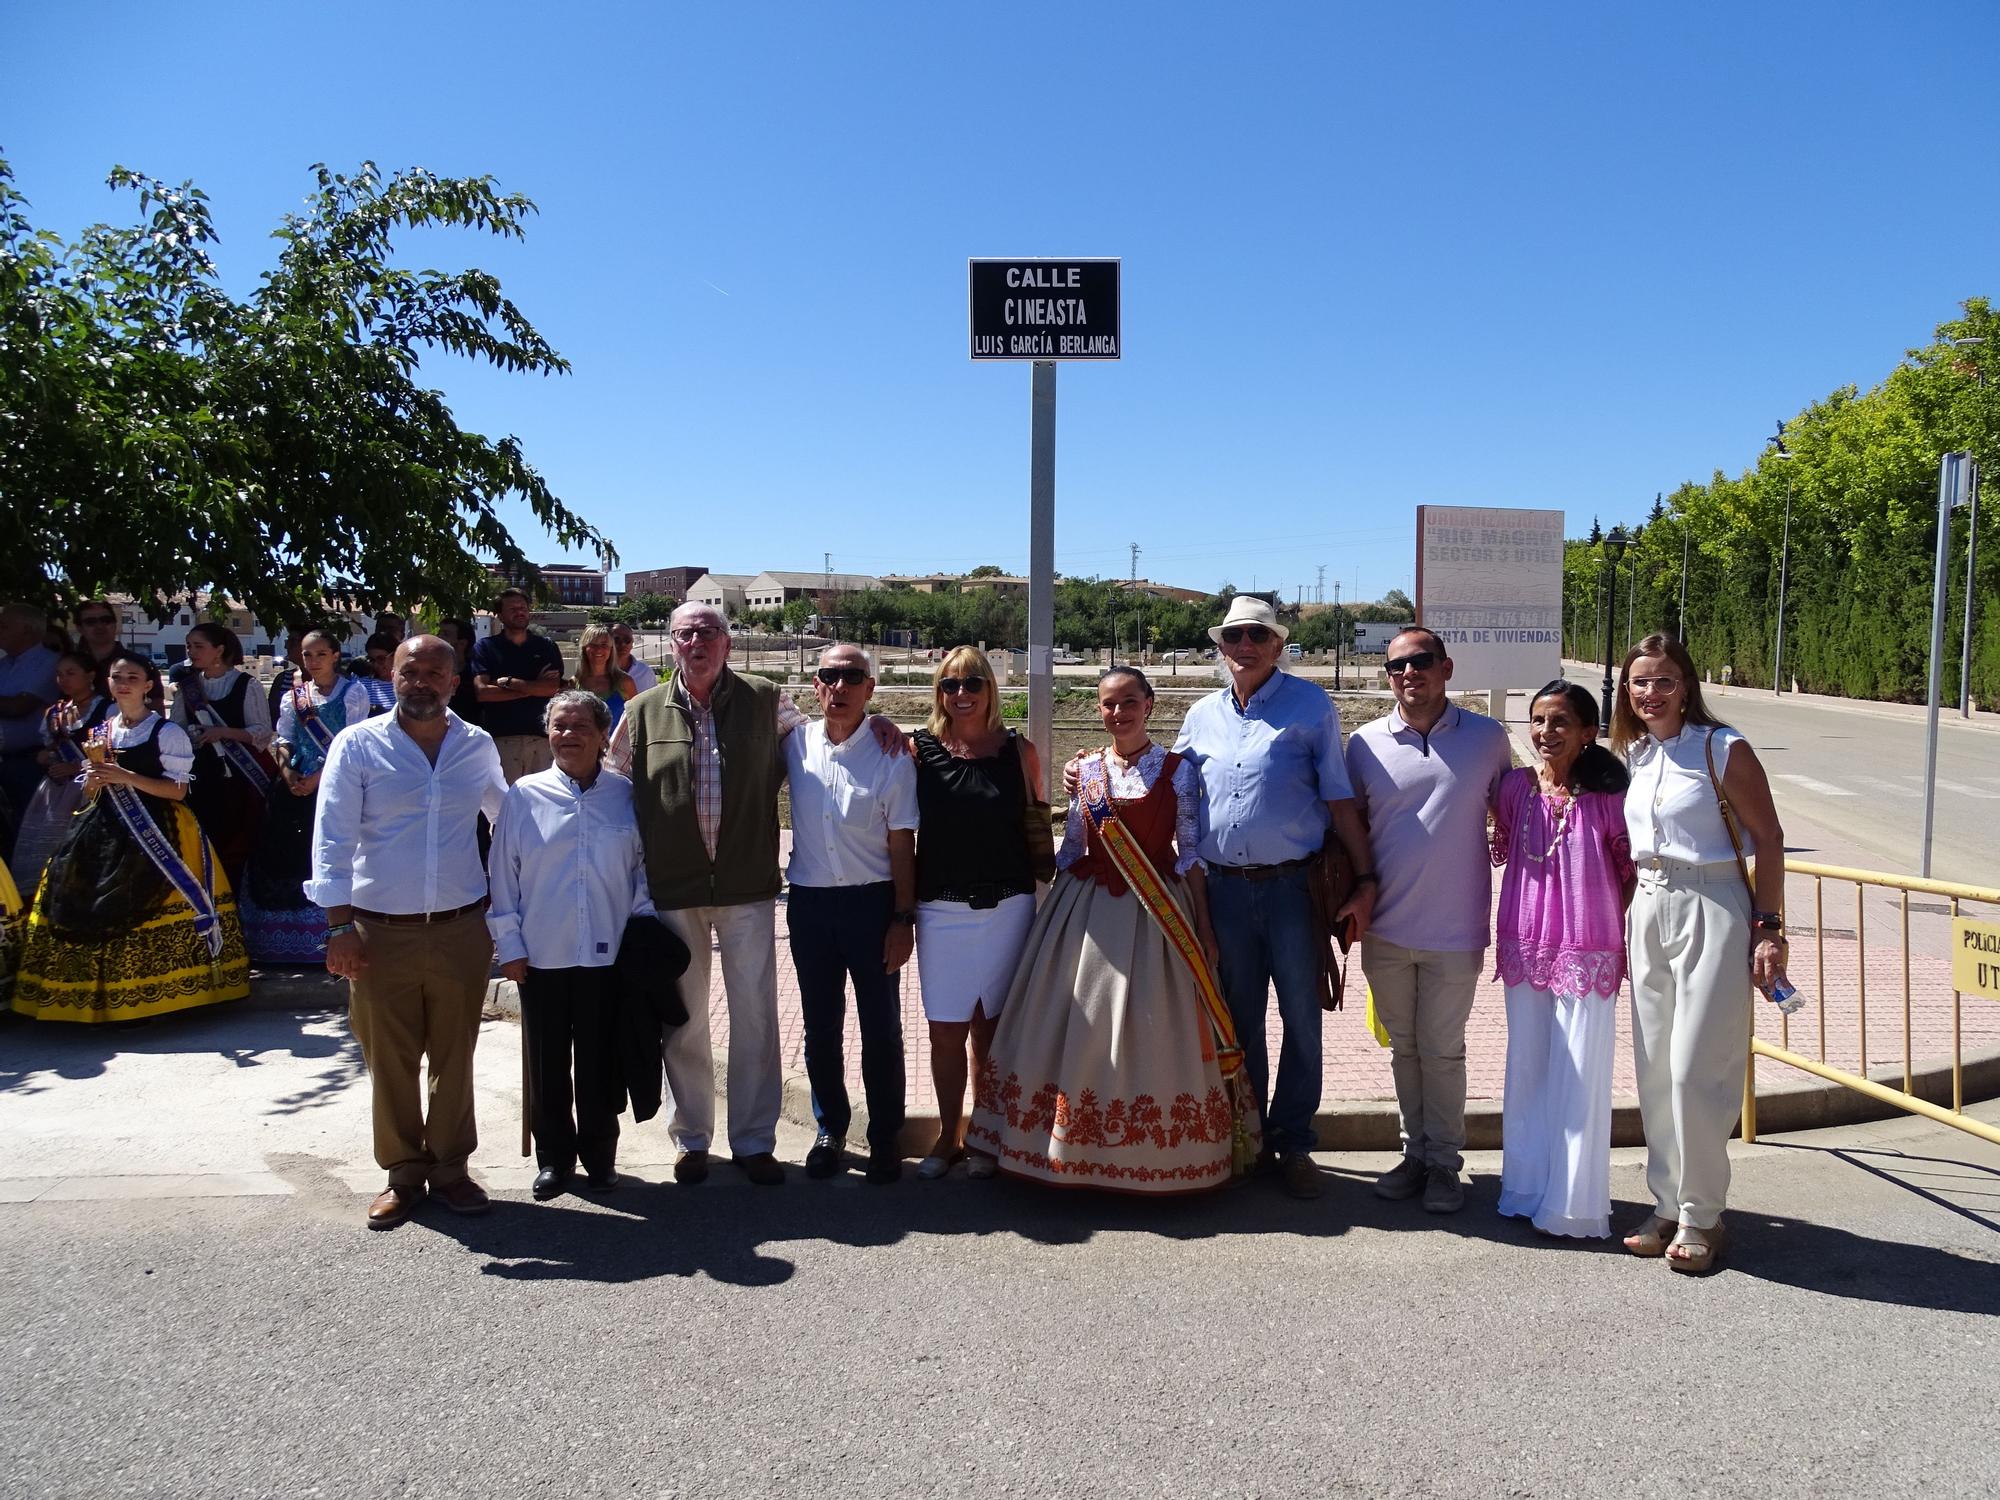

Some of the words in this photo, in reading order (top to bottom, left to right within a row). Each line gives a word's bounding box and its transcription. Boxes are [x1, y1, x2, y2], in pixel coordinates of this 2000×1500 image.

[1006, 268, 1081, 288] CALLE
[1004, 298, 1087, 325] CINEASTA
[975, 335, 1004, 353] LUIS
[1010, 330, 1053, 354] GARCÍA
[1060, 335, 1116, 354] BERLANGA
[1428, 546, 1492, 561] SECTOR
[1473, 631, 1490, 643] DE
[1495, 631, 1560, 643] VIVIENDAS
